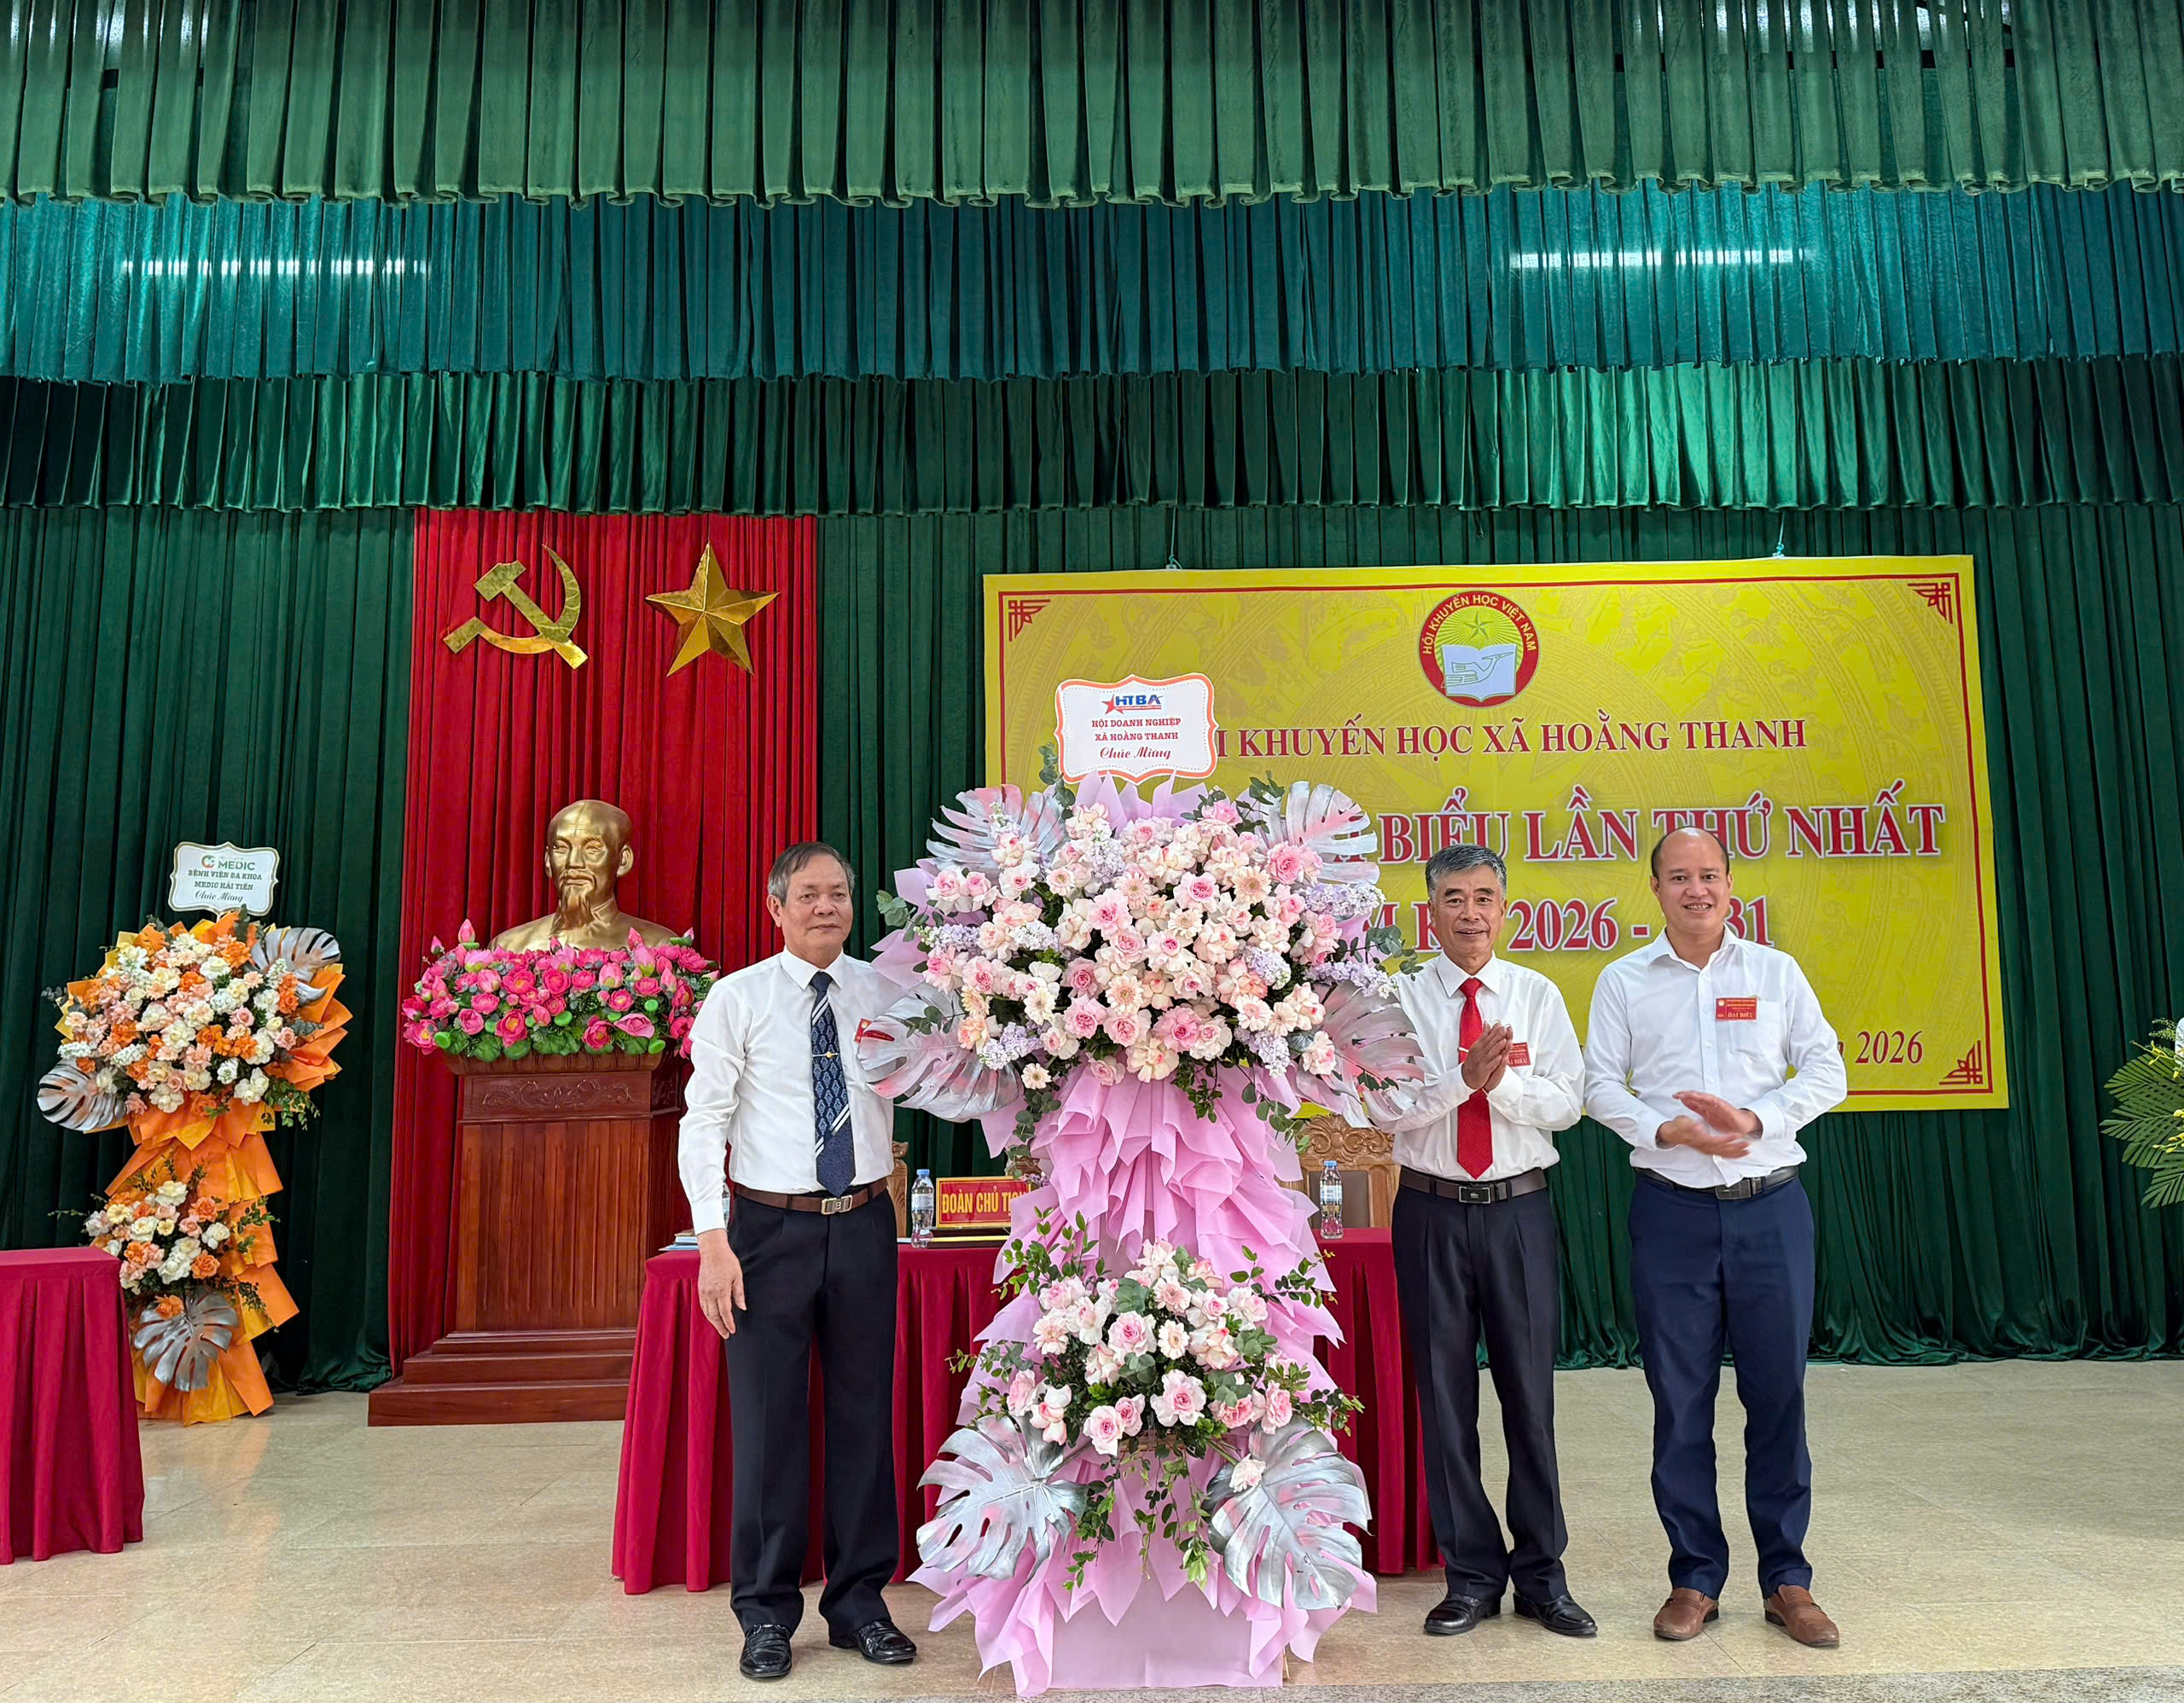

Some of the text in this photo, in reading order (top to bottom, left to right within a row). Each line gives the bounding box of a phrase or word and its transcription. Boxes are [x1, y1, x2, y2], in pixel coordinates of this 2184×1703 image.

[1422, 594, 1537, 654] HỘI KHUYẾN HỌC VIỆT NAM
[1115, 695, 1162, 706] HTBA
[1091, 717, 1182, 729] HỘI DOANH NGHIỆP
[1144, 732, 1179, 741] THANH
[1237, 713, 1386, 758] KHUYẾN
[1396, 724, 1473, 762] HỌC
[1481, 717, 1531, 753] XÃ
[1540, 708, 1670, 753] HOẰNG
[1679, 719, 1808, 750] THANH
[1100, 746, 1171, 760] Chúc Mừng
[1377, 785, 1510, 864] BIỂU
[1523, 784, 1640, 862] LẦN
[1783, 778, 1946, 859] NHẤT
[218, 861, 255, 870] MEDIC
[194, 881, 218, 889] MEDIC
[1507, 898, 1619, 952] 2026
[1631, 924, 1650, 939] -
[1856, 1030, 1924, 1065] 2026
[942, 1189, 973, 1214] ĐOÀN
[976, 1185, 999, 1214] CHỦ
